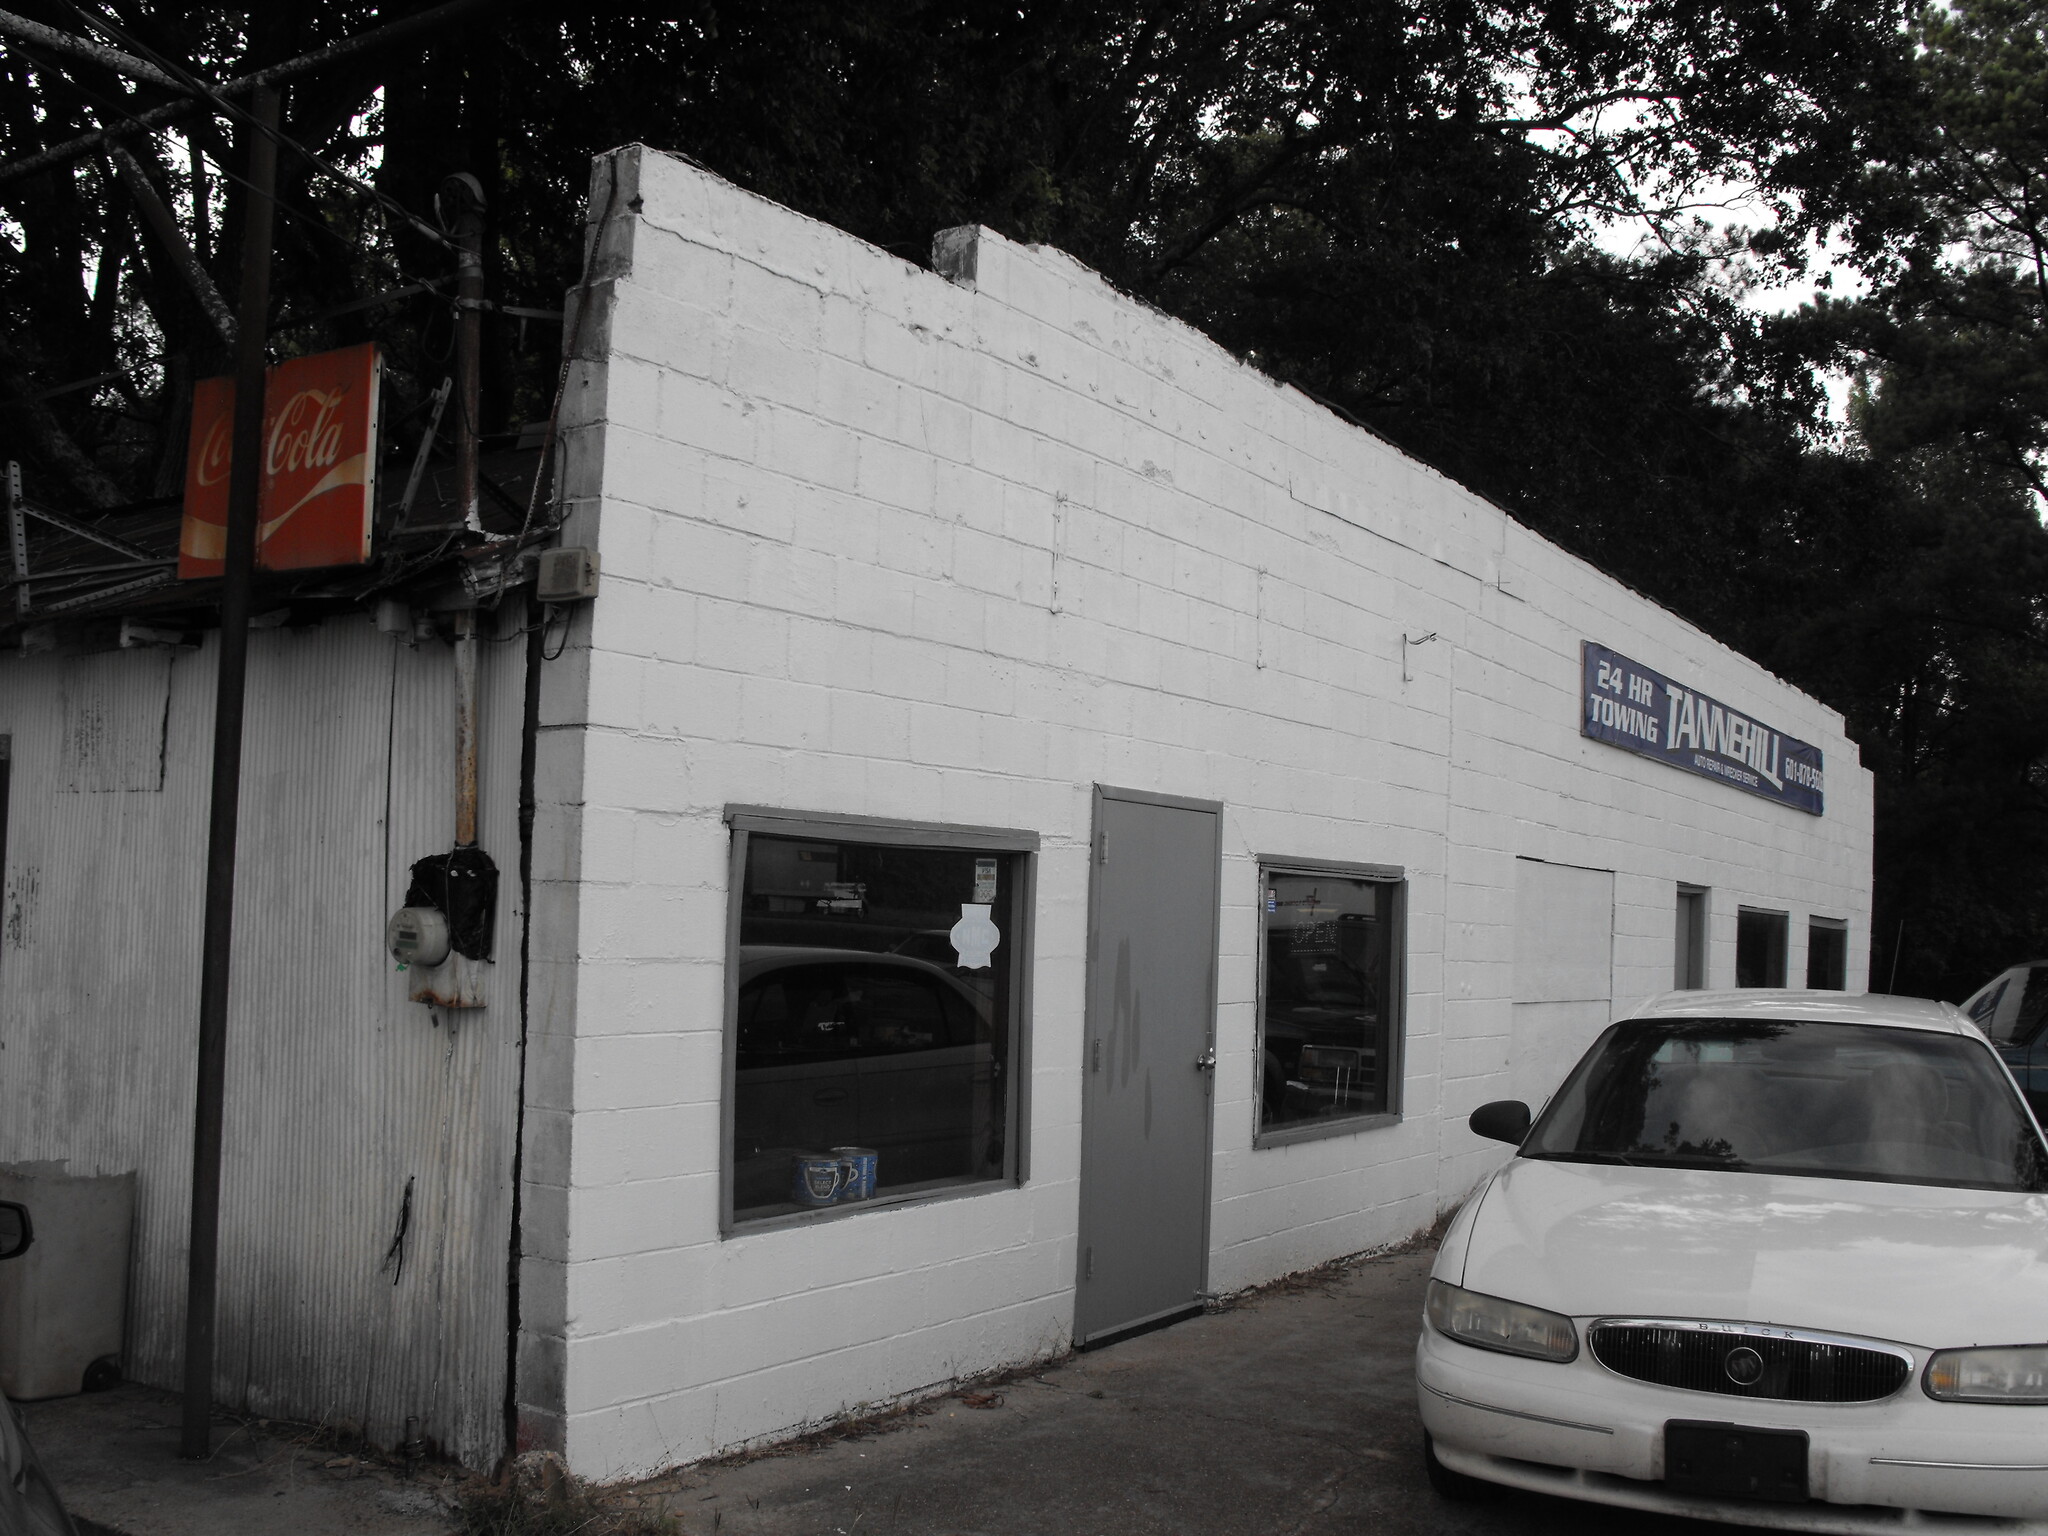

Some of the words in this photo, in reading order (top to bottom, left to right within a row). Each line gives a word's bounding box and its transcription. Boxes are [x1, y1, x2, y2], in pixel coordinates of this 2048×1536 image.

[266, 387, 344, 475] Cola
[1597, 660, 1623, 695] 24
[1627, 673, 1653, 707] HR
[1590, 693, 1658, 744] TOWING
[1666, 683, 1783, 792] TANNEHILL
[1294, 920, 1337, 944] OPEN
[1698, 1323, 1794, 1339] BUICK
